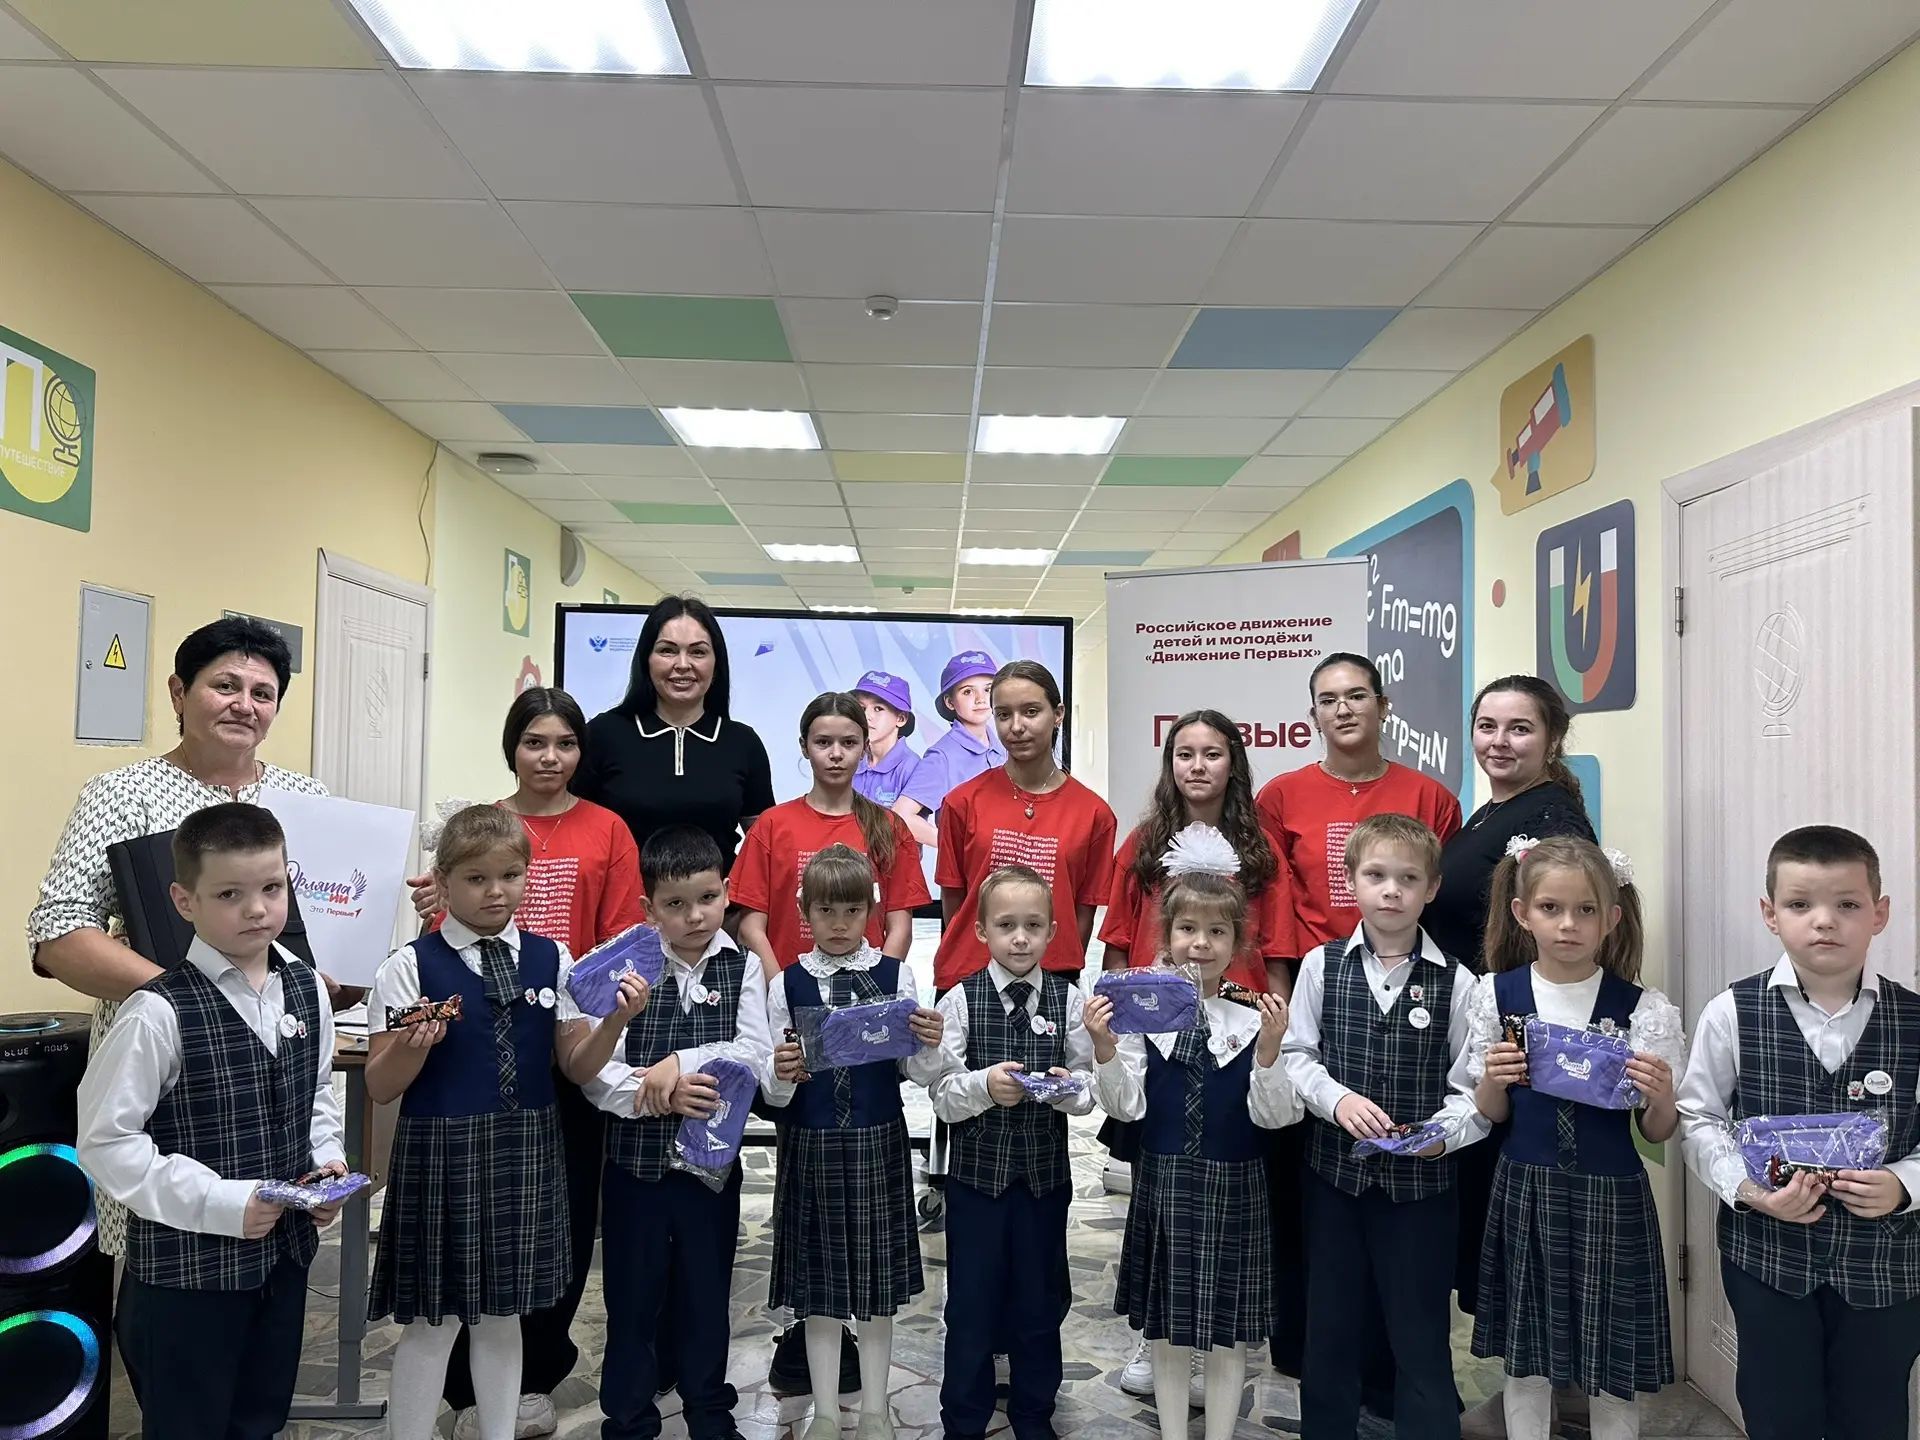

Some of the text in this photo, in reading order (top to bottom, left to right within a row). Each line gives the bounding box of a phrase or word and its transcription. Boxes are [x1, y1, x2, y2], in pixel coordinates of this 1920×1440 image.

[1135, 616, 1333, 634] Российское движение
[1153, 632, 1313, 649] детей и молодёжи
[1145, 648, 1321, 664] «Движение Первых»
[1153, 715, 1312, 748] Пвые
[309, 905, 355, 917] Это Первые
